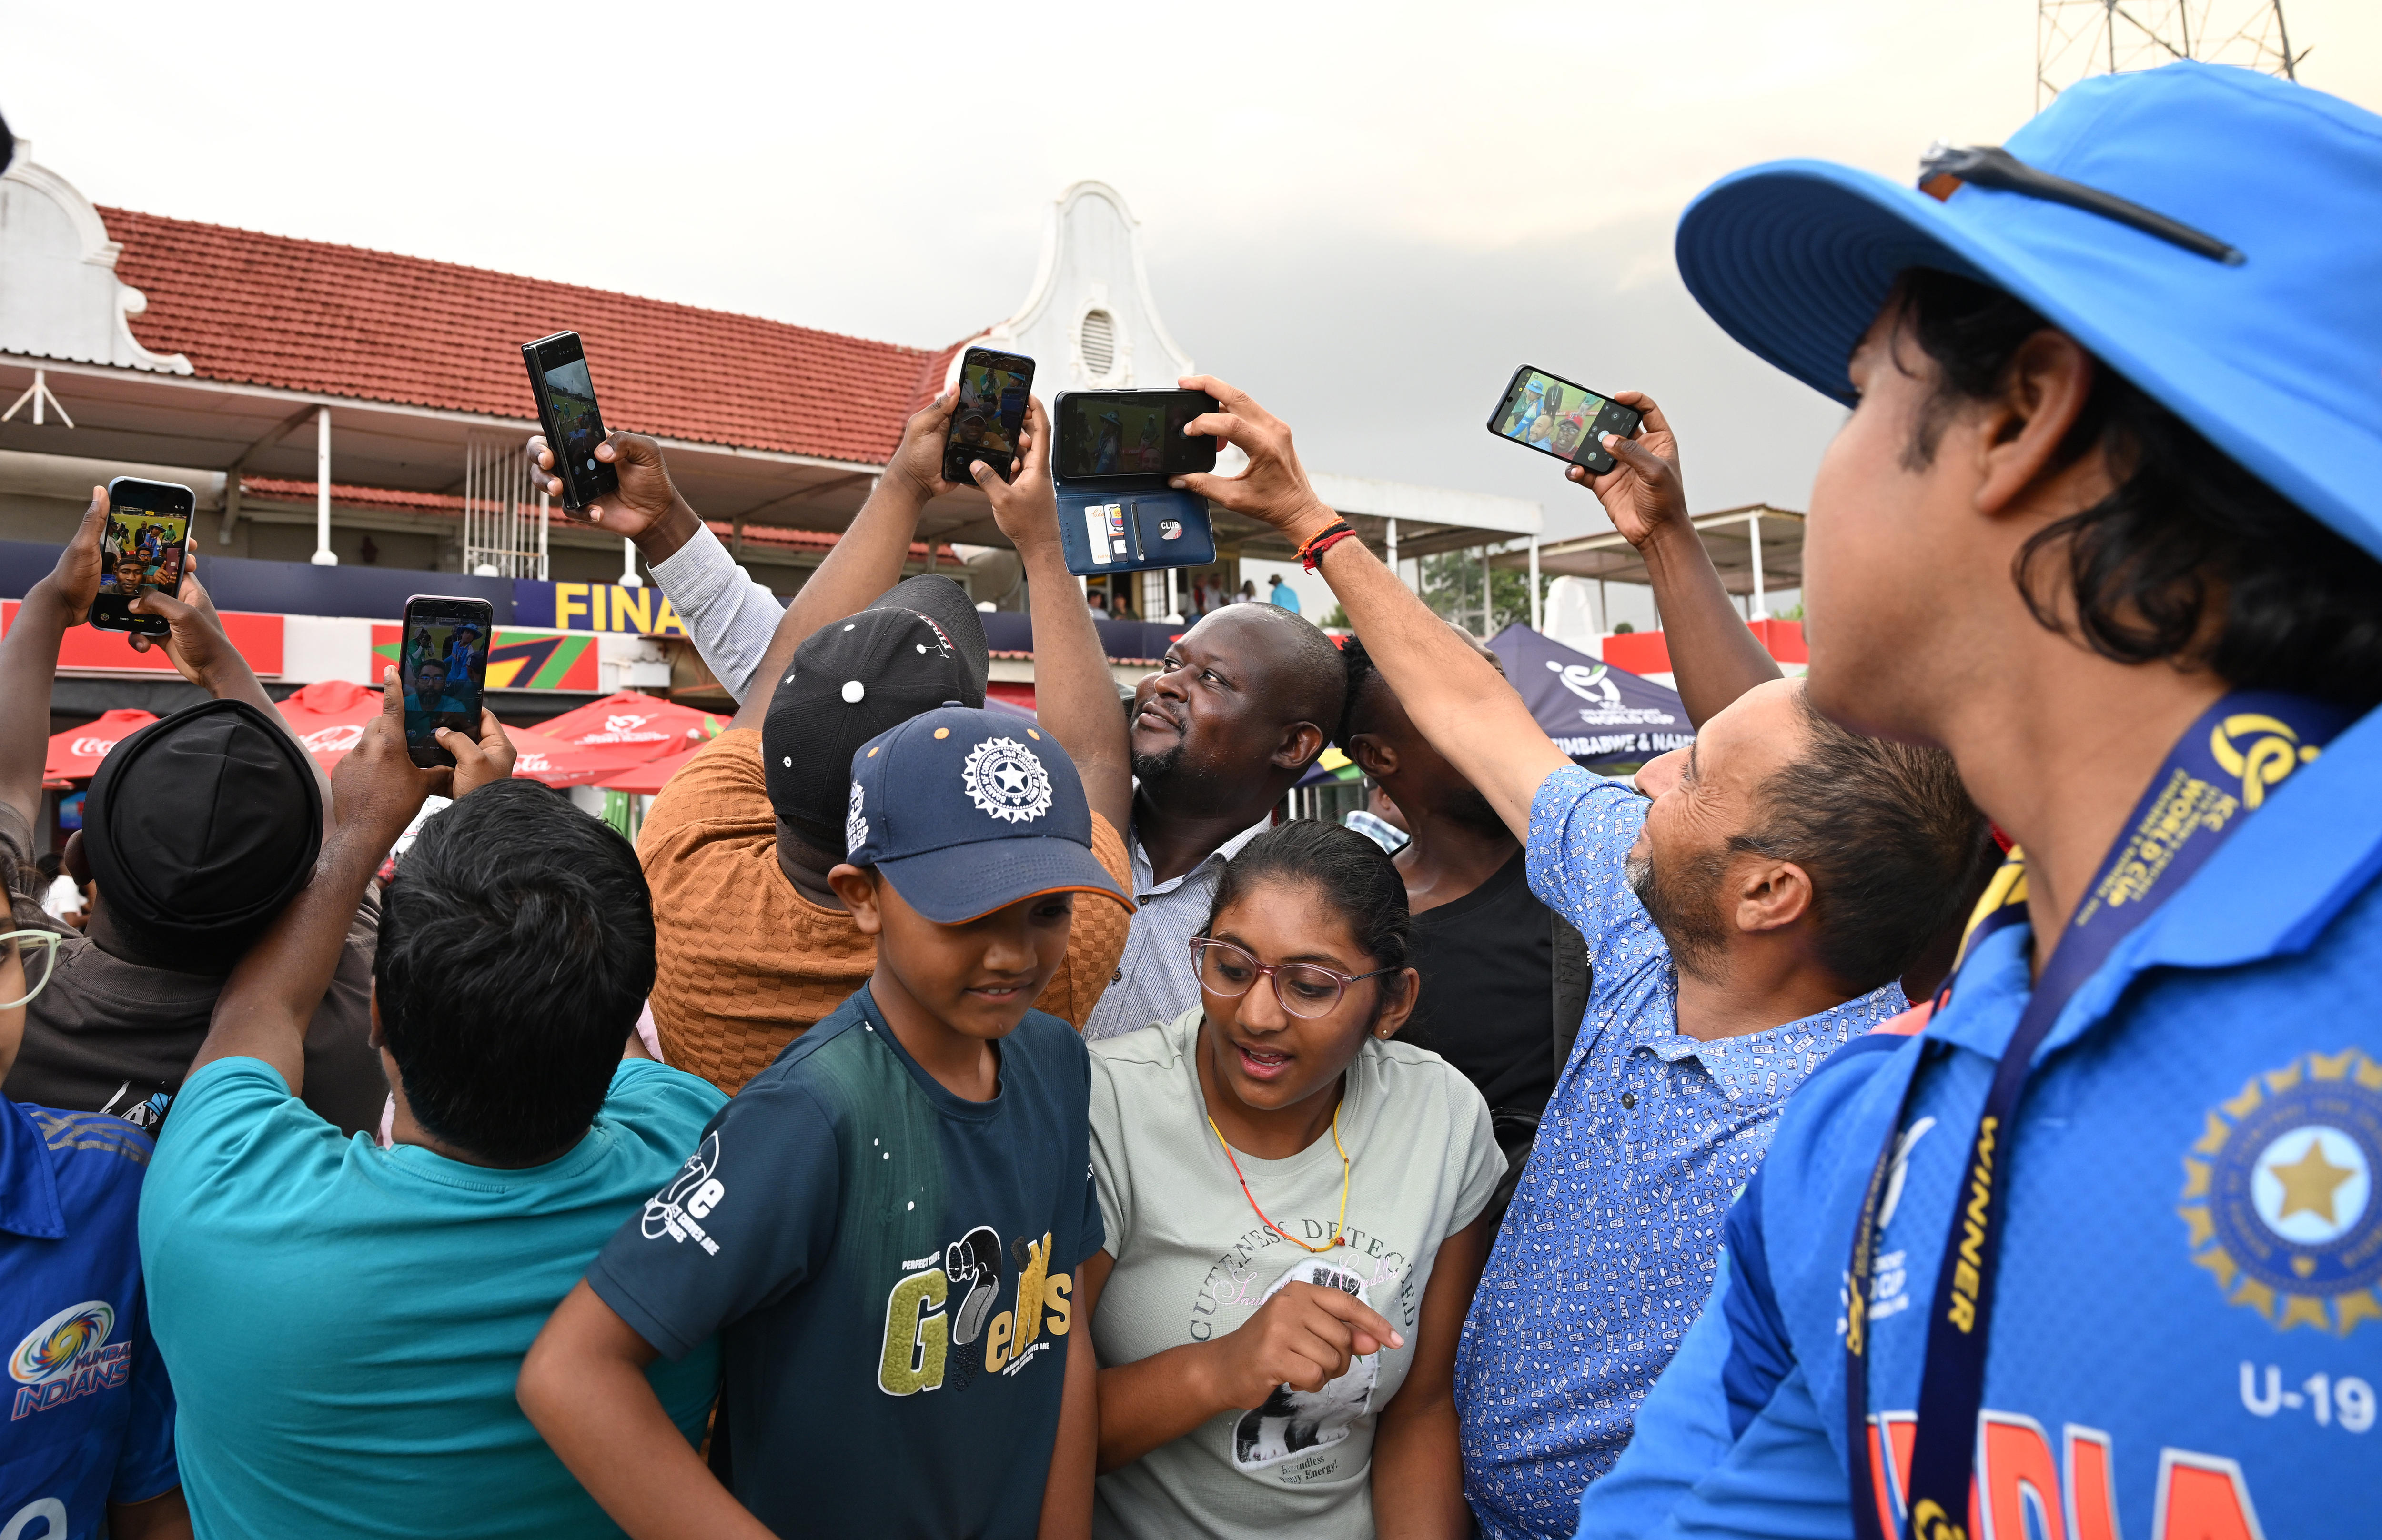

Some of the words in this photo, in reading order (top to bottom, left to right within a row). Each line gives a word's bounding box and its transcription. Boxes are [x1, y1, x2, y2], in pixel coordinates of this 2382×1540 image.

[1161, 521, 1180, 530] CLUB
[555, 582, 687, 634] FINA
[916, 614, 953, 650] FIRST
[981, 751, 1003, 774] CONTROL
[1018, 754, 1038, 778] CRICKET
[981, 775, 989, 785] OF
[985, 784, 1007, 804] BOARD
[855, 817, 866, 830] T20
[2139, 778, 2210, 861] WORLD
[857, 825, 869, 840] CUP
[2108, 860, 2148, 906] CUP
[1948, 1116, 1998, 1334] WINNER
[902, 1257, 929, 1270] PERFECT
[1191, 1221, 1293, 1342] CUTENESS
[1302, 1218, 1415, 1327] DETECTED
[11, 1356, 130, 1421] INDIANS
[2239, 1361, 2377, 1433] U-19
[1305, 1459, 1338, 1480] Energy!
